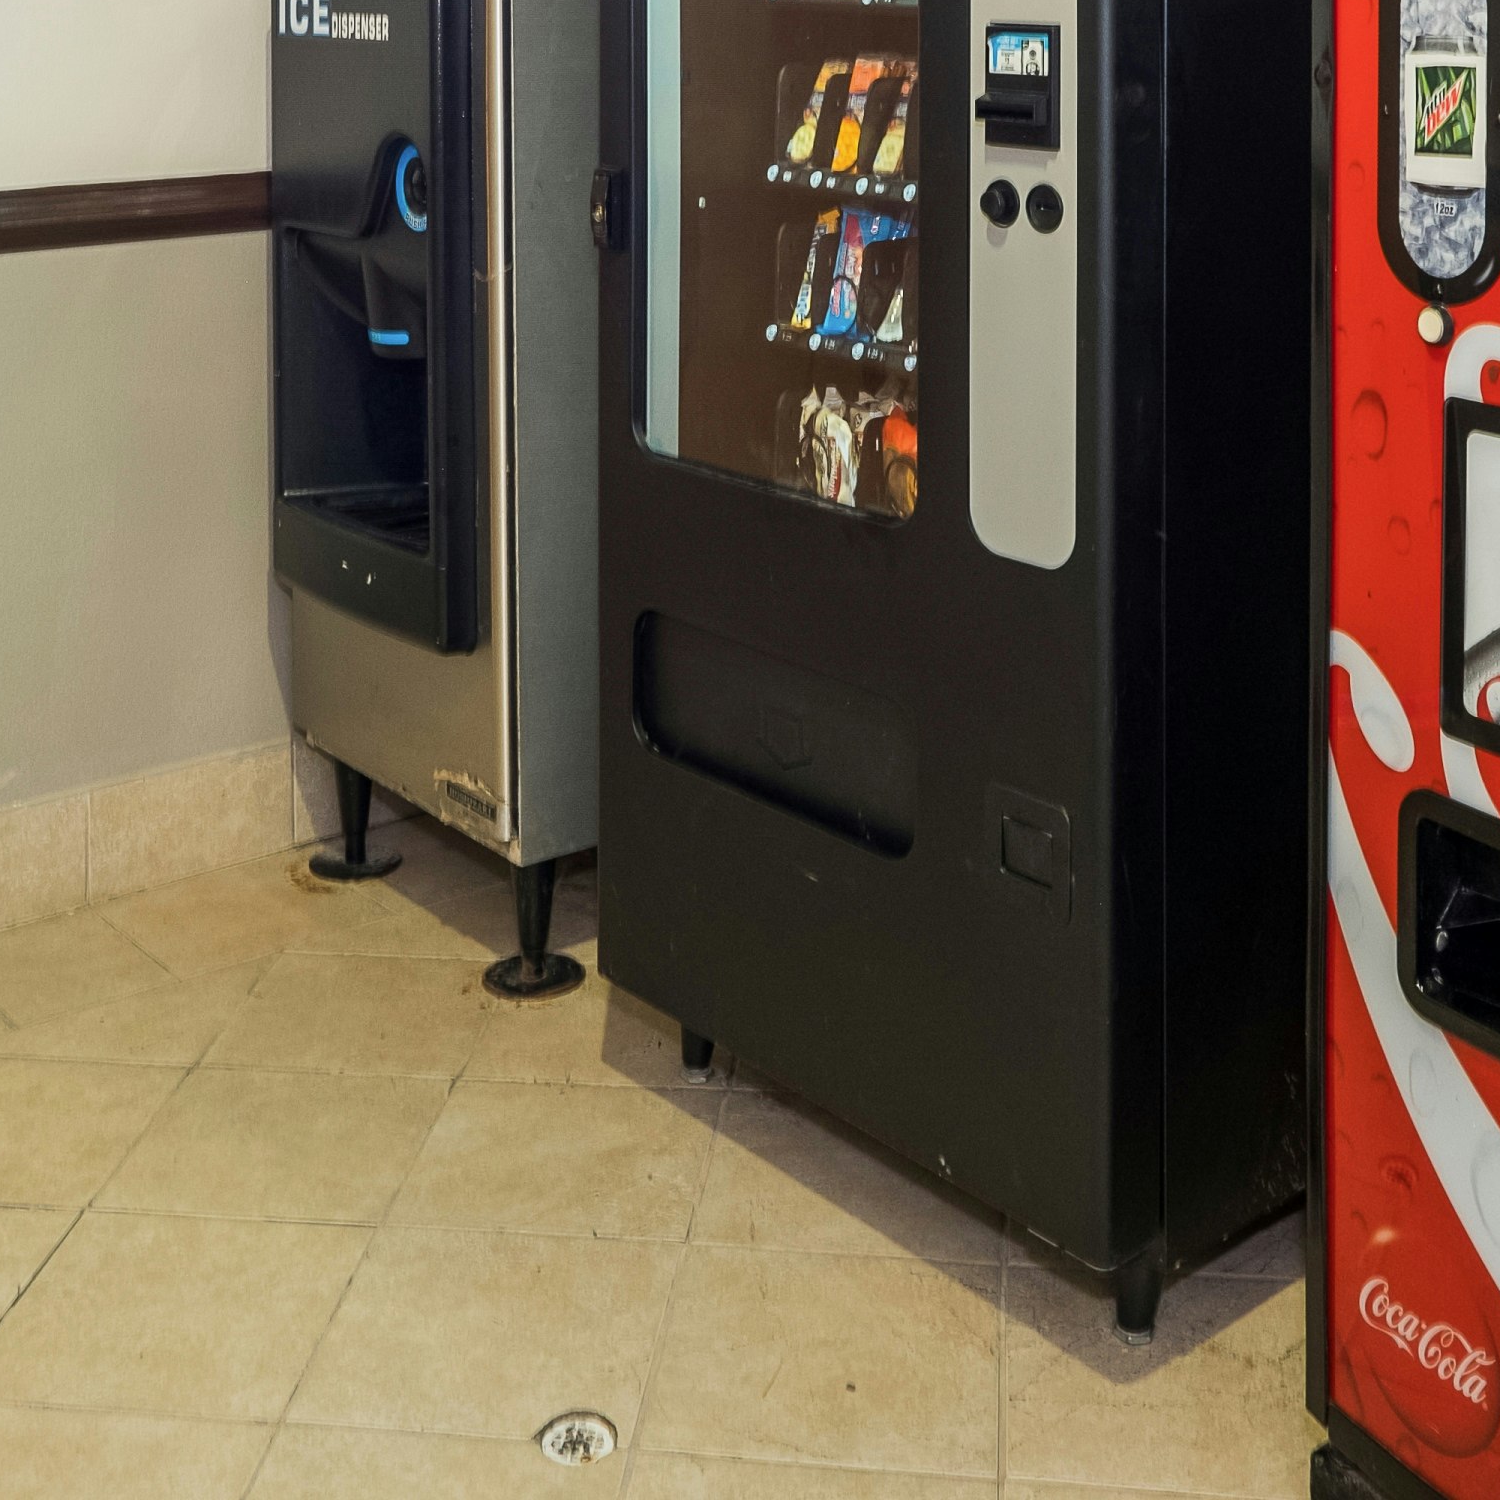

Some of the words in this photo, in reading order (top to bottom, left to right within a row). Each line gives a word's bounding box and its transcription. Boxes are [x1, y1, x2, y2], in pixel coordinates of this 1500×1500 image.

[331, 11, 389, 41] DISPENSER
[1435, 202, 1455, 216] 12oz
[1358, 1278, 1496, 1405] Coca-Cola
